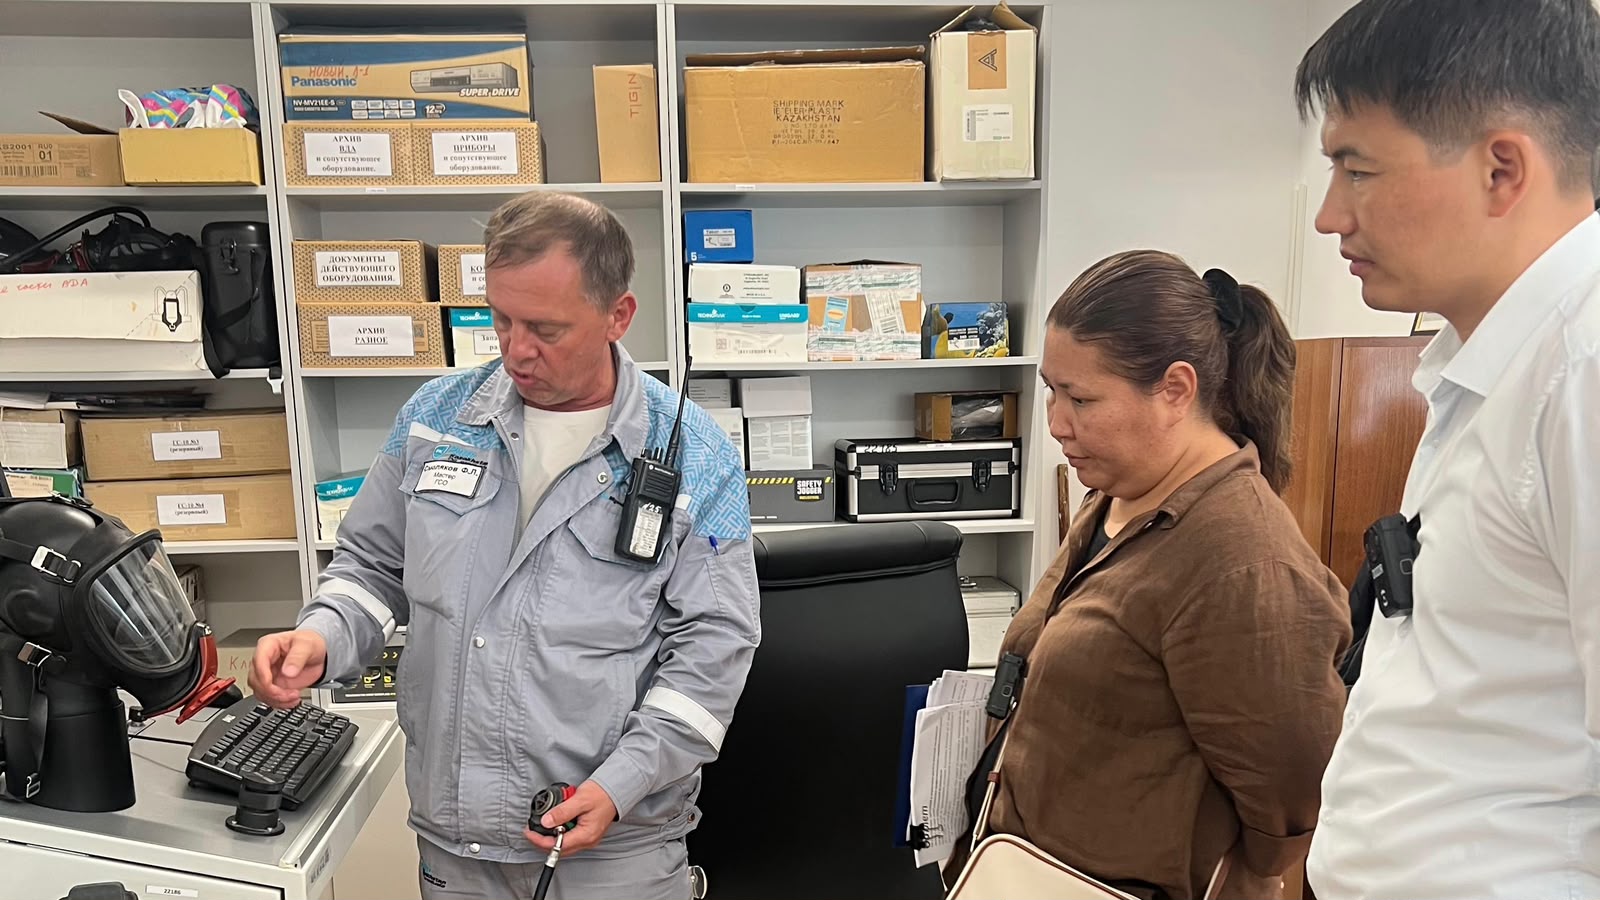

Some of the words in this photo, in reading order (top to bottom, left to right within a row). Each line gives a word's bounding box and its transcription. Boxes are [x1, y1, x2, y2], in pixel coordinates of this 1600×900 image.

[291, 75, 357, 87] Panasonic
[459, 88, 488, 97] SUPER
[491, 87, 520, 97] DRIVE
[773, 99, 814, 107] SHIPPING
[817, 99, 844, 107] MARK
[776, 114, 840, 122] KAZAKHSTAN
[460, 134, 488, 142] АРХИВ
[339, 145, 357, 153] ВДА
[453, 144, 497, 152] ПРИБОРЫ
[39, 150, 52, 161] 01
[329, 255, 386, 263] ДОКУМЕНТЫ
[690, 251, 698, 261] 5
[320, 264, 396, 273] ДЕЙСТВУЮЩЕГО
[355, 336, 388, 344] РАЗНОЕ
[433, 472, 456, 480] Мастер
[796, 479, 822, 488] SAFETY
[796, 487, 822, 495] JOGGER
[163, 888, 182, 896] 22186
